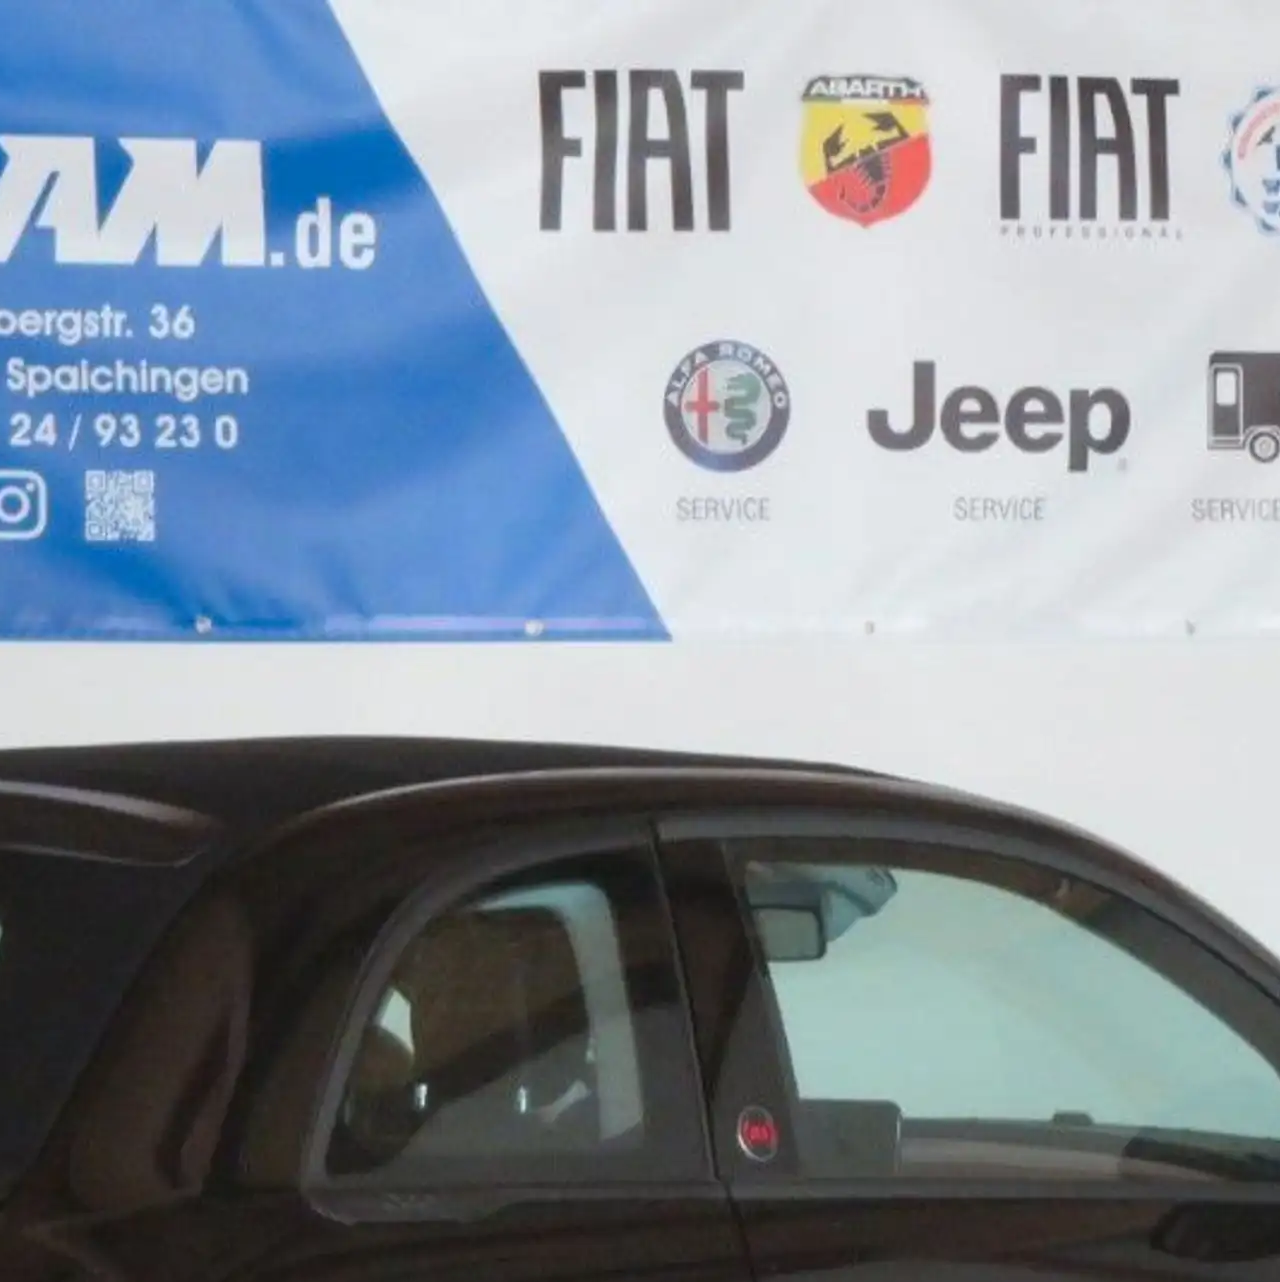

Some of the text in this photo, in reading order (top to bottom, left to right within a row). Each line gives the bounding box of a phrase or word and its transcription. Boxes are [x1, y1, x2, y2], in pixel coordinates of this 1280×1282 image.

[808, 77, 924, 98] ABARTH
[539, 70, 744, 231] FIAT
[1000, 74, 1180, 221] FIAT
[148, 304, 196, 339] 36
[7, 357, 250, 401] Spaichingen
[666, 342, 787, 409] ALFA ROMEO
[10, 413, 57, 446] 24
[69, 414, 82, 450] /
[94, 414, 142, 448] 93
[155, 415, 201, 448] 23
[215, 415, 238, 449] 0
[867, 361, 1131, 473] Jeep
[676, 497, 771, 521] SERVICE
[954, 497, 1046, 521] SERVICE
